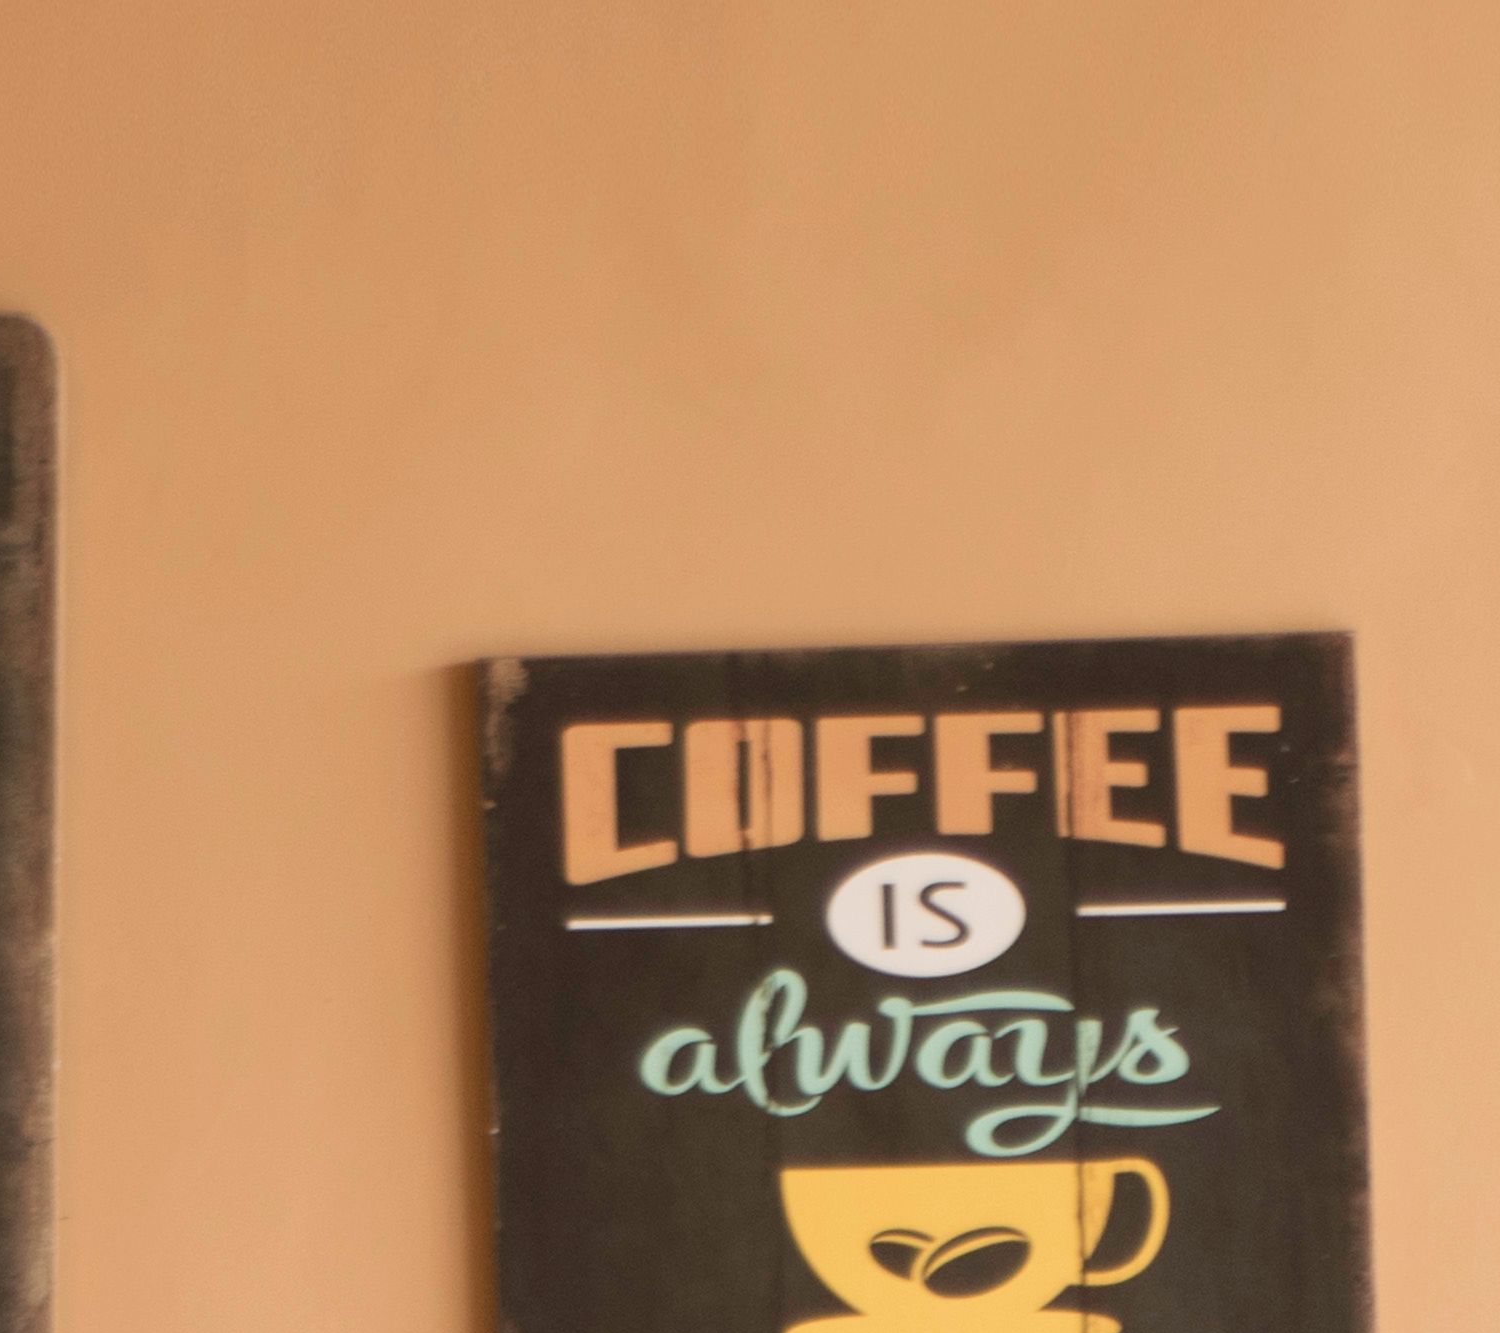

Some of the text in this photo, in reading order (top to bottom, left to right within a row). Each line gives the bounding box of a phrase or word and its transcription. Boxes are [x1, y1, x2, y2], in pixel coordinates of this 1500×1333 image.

[559, 704, 1286, 886] COFFEE
[879, 880, 972, 951] IS
[639, 968, 1221, 1157] always
